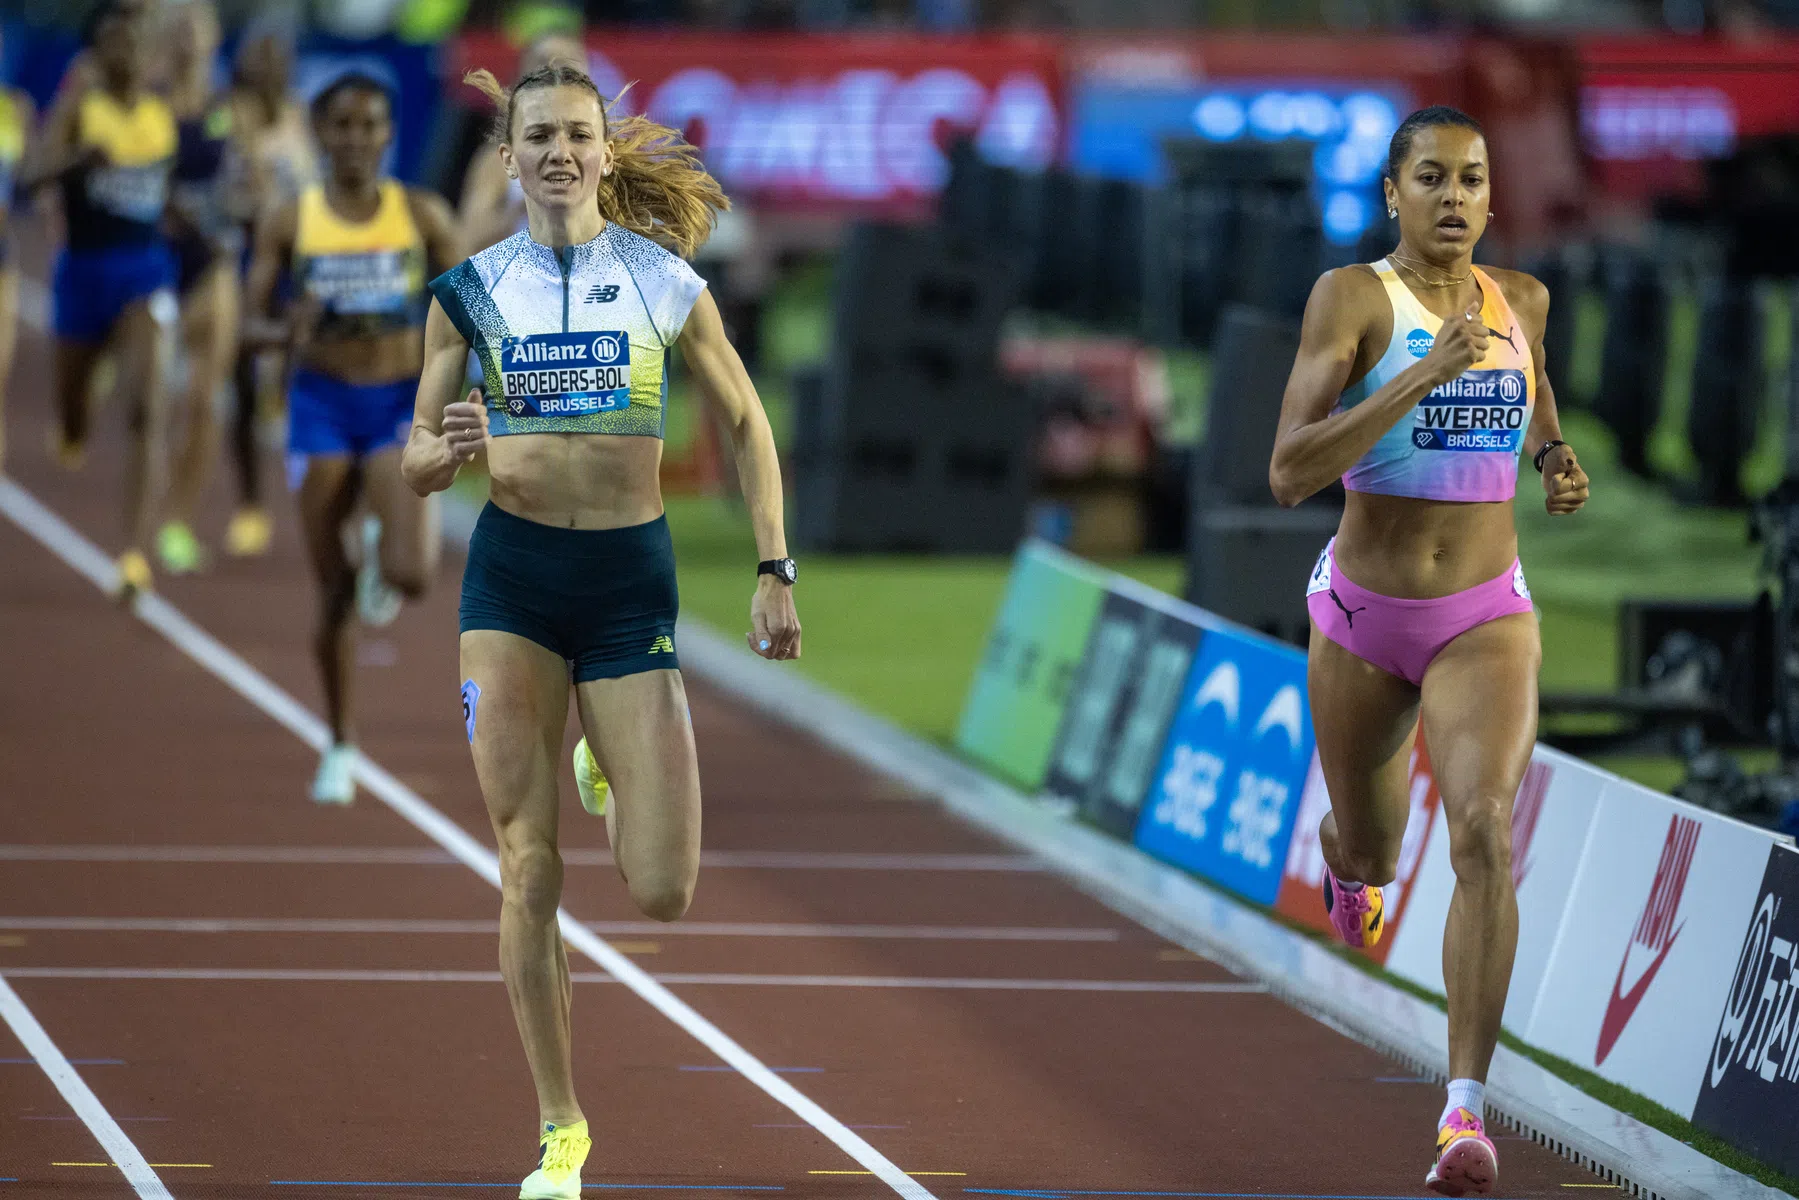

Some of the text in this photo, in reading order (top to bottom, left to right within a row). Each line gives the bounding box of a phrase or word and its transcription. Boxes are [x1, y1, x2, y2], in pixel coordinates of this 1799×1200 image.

[512, 342, 587, 363] Allianz
[506, 367, 626, 395] BROEDERS-BOL
[1430, 379, 1495, 398] Allianz
[540, 395, 615, 413] BRUSSELS
[1424, 407, 1523, 429] WERRO
[1447, 434, 1511, 448] BRUSSELS
